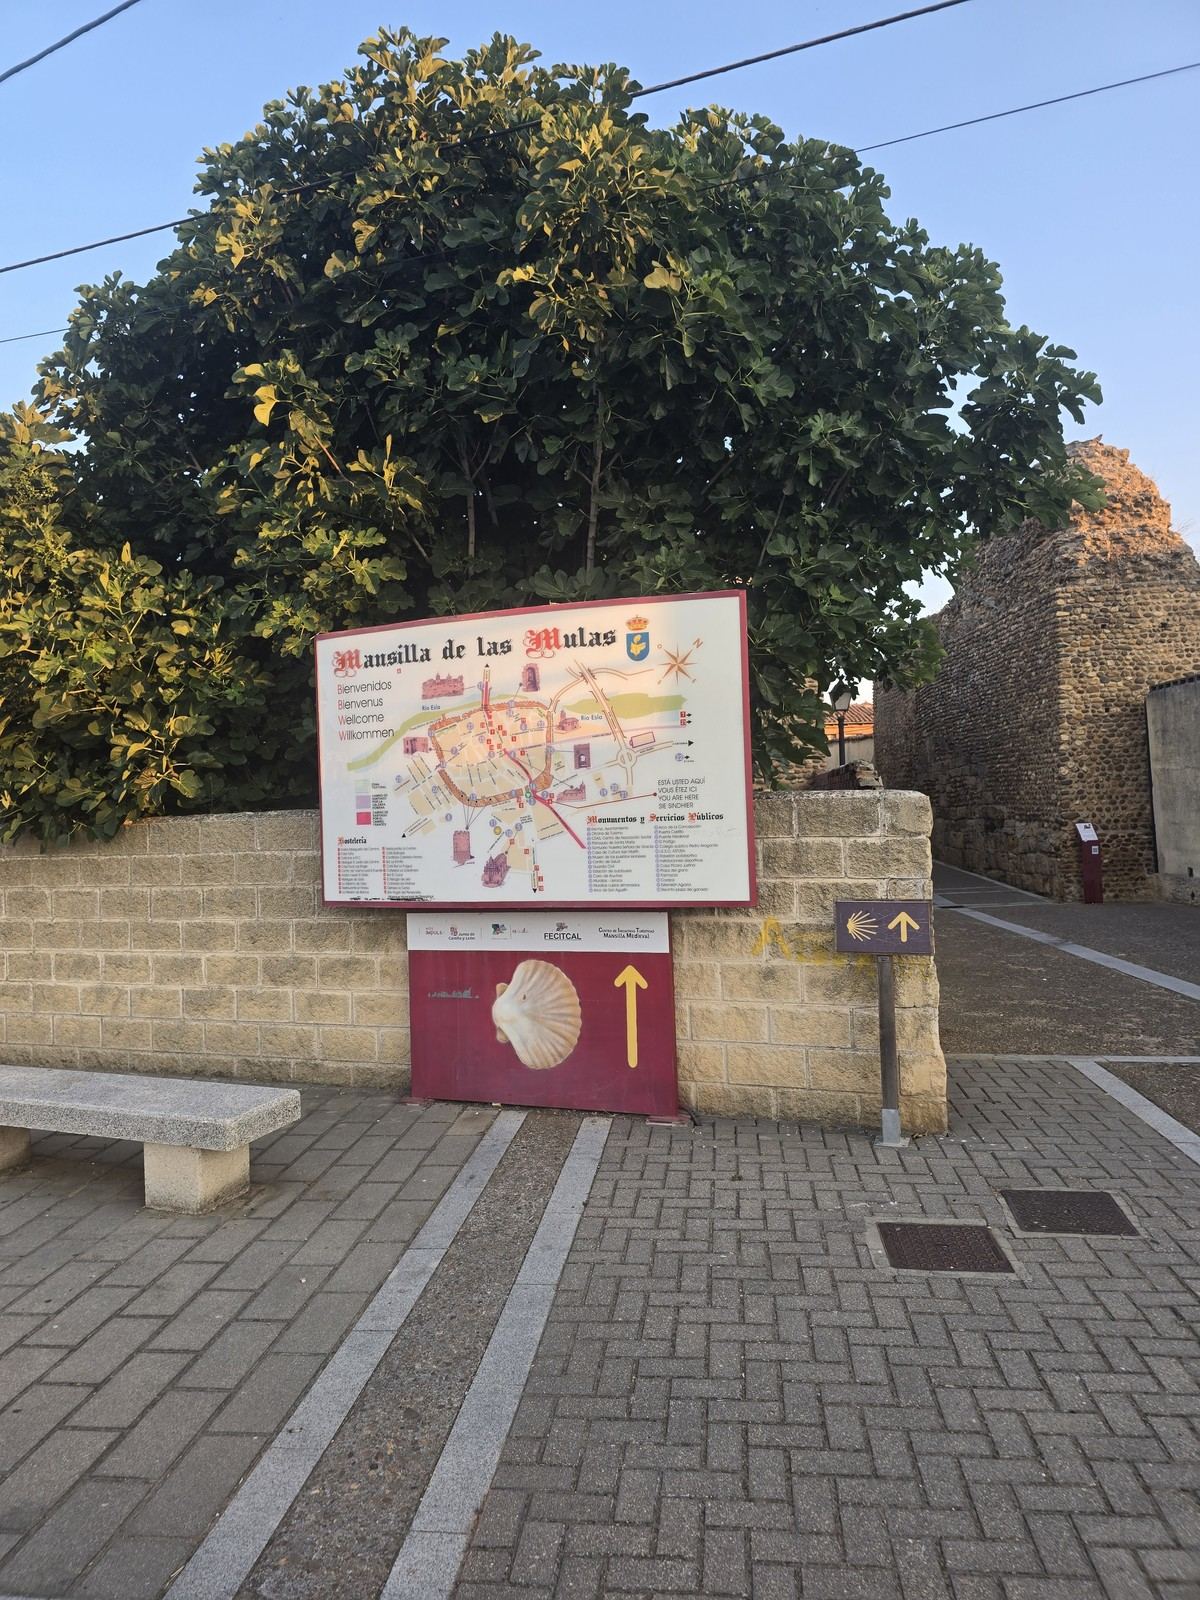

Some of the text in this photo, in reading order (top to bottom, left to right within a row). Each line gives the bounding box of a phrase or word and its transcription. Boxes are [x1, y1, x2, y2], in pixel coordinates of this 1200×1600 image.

[333, 626, 616, 677] Mansilla de las Mulas
[337, 680, 392, 694] Bienvenidos
[338, 697, 384, 710] Bienvenus
[338, 713, 385, 726] Wellcome
[338, 728, 395, 741] Willkommen
[586, 815, 637, 826] Monumentos
[649, 813, 685, 822] Servicios
[543, 932, 581, 940] FECITCAL
